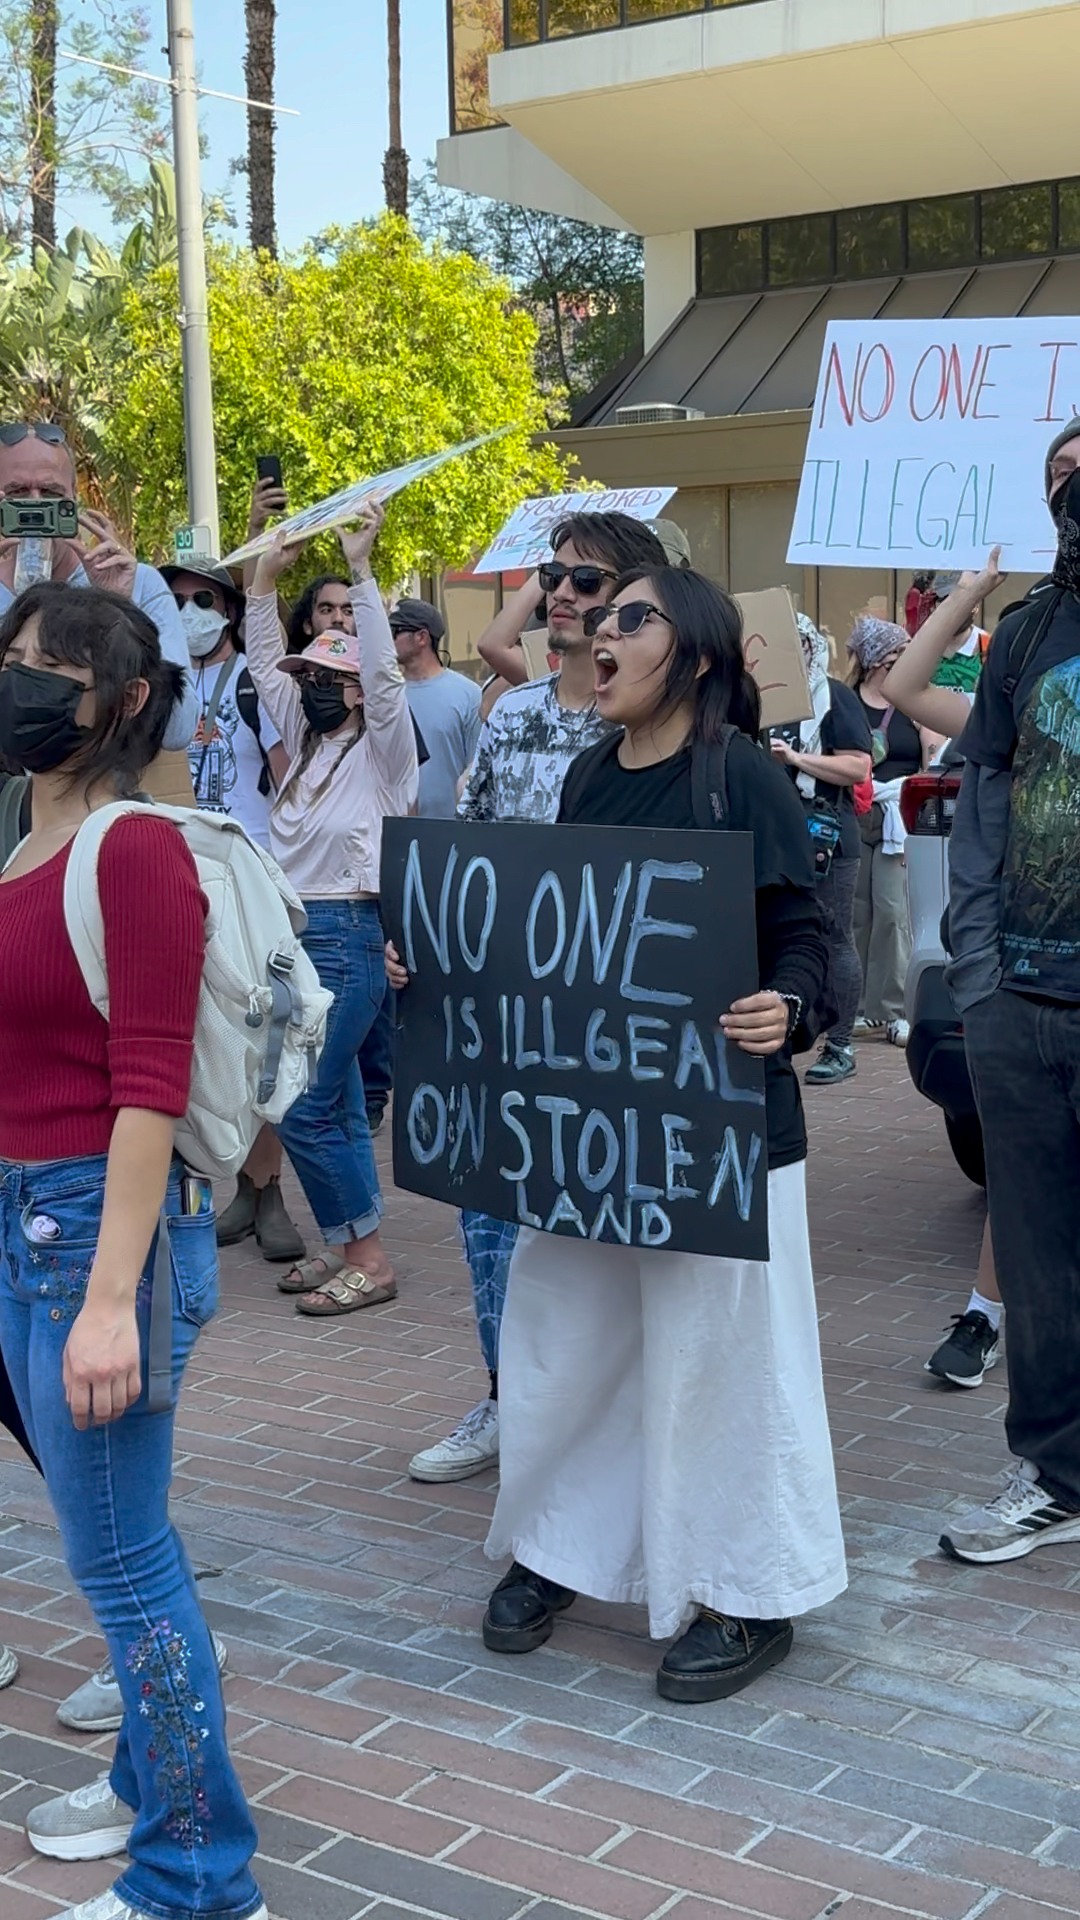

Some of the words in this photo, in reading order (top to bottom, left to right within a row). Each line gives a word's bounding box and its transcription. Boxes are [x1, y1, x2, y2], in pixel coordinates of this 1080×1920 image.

[819, 342, 895, 429] NO
[909, 344, 1012, 422] ONE
[1034, 342, 1080, 422] I
[178, 531, 191, 547] 30
[520, 497, 572, 522] YOU
[580, 490, 662, 511] POKED
[794, 457, 1014, 551] ILLEGAL
[402, 838, 498, 975] NO
[525, 858, 707, 1006] ONE
[444, 993, 483, 1063] IS
[501, 994, 764, 1104] ILLGEAL
[499, 1089, 762, 1221] STOLEN
[515, 1181, 672, 1246] LAND
